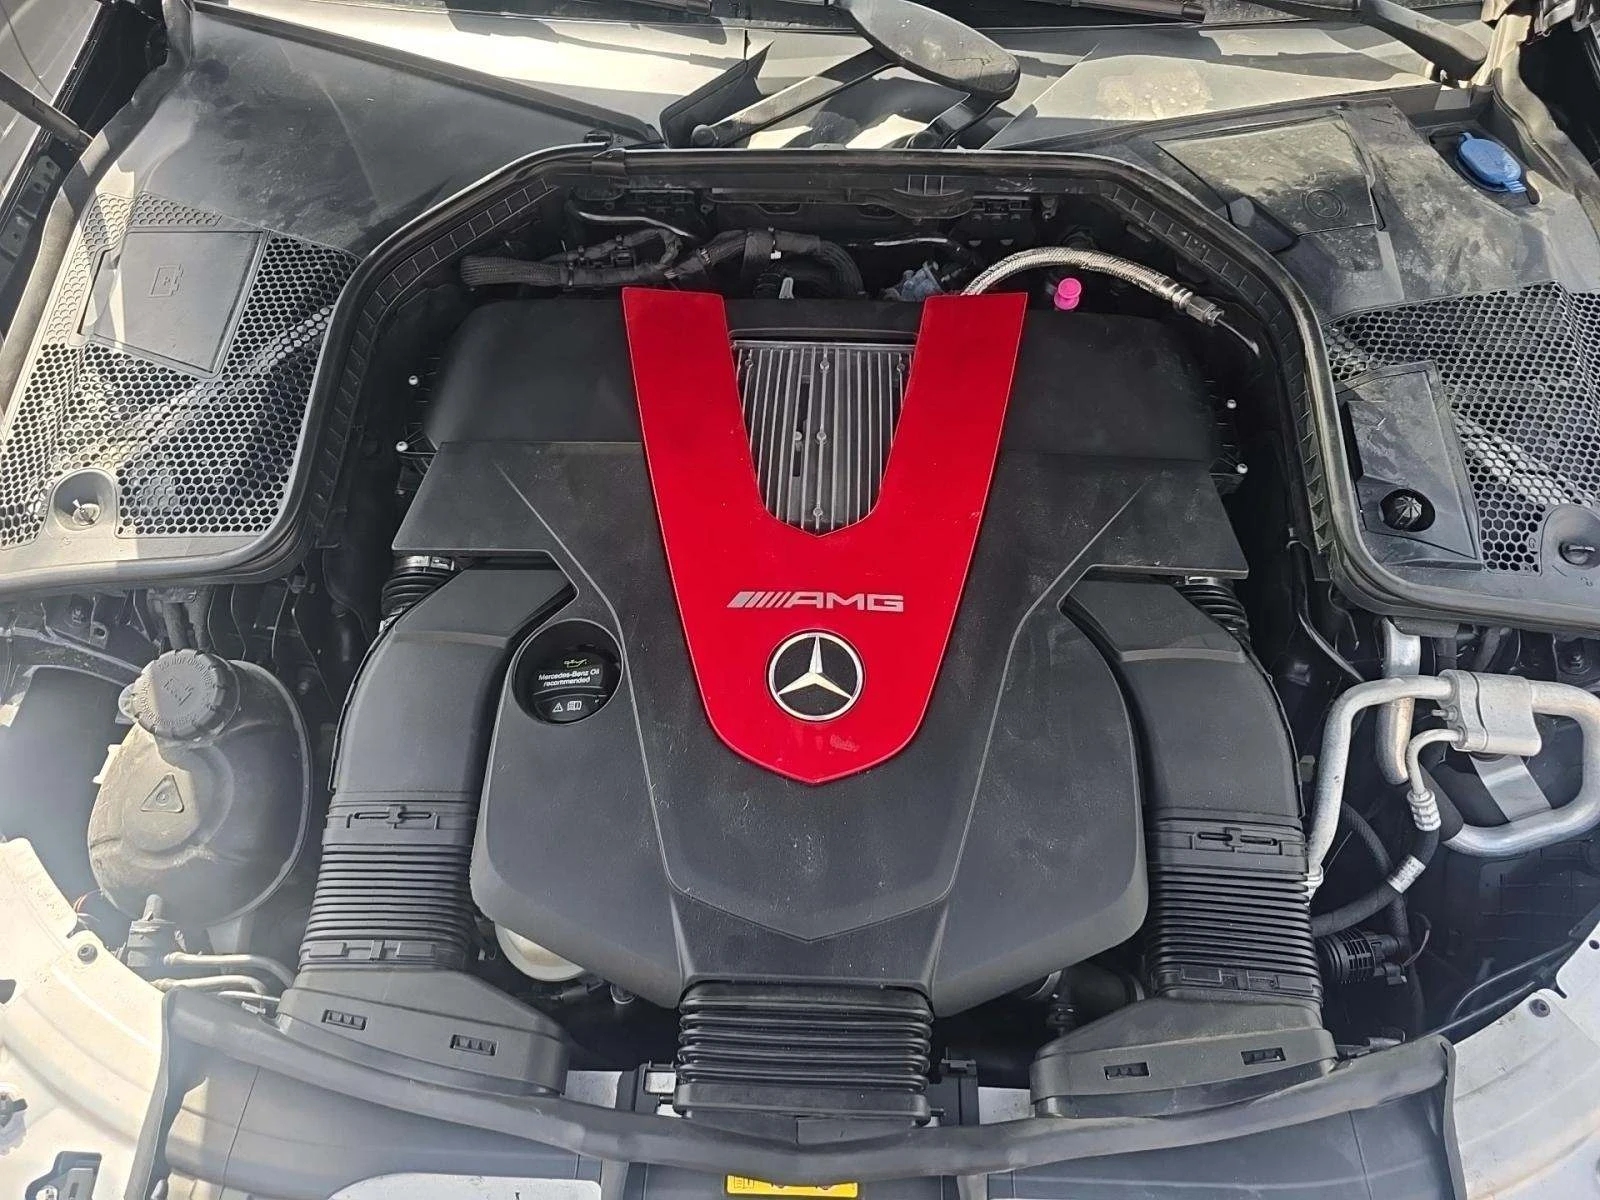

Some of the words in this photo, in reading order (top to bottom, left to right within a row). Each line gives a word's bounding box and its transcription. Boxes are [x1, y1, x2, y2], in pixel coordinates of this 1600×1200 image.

[783, 591, 904, 613] AMG
[538, 670, 589, 681] Mercedes-Benz
[589, 668, 600, 676] Oil
[543, 676, 591, 687] recommended
